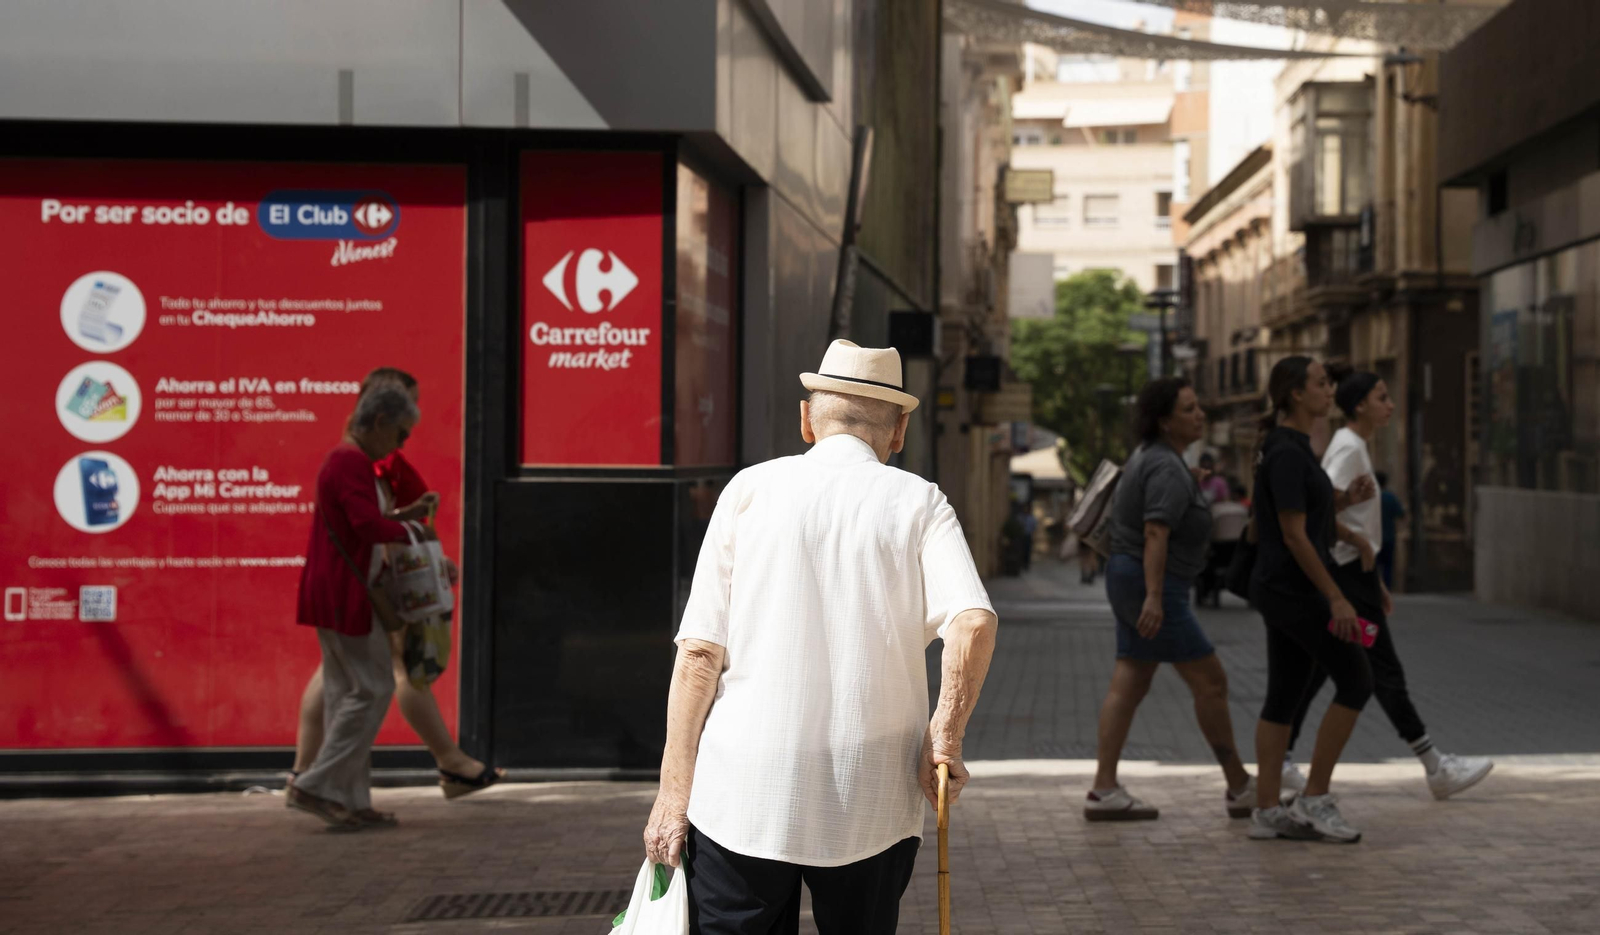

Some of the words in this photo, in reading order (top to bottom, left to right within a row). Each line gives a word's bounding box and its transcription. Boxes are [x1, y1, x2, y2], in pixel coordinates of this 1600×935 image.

[41, 199, 90, 223] Por
[94, 205, 137, 223] ser
[141, 200, 209, 224] socio
[215, 201, 250, 225] de
[269, 204, 290, 224] El
[297, 204, 347, 225] Club
[330, 237, 397, 266] ¿Vienes?
[159, 296, 190, 309] Todo
[192, 297, 206, 309] tu
[207, 297, 246, 309] ahorro
[247, 300, 255, 311] y
[258, 298, 276, 309] tus
[279, 298, 343, 310] descuentos
[345, 298, 382, 312] juntos
[159, 315, 176, 325] en
[177, 313, 191, 325] tu
[192, 310, 315, 328] ChequeAhorro
[529, 321, 649, 345] Carrefour
[548, 347, 632, 370] market
[155, 377, 215, 393] Ahorra
[219, 377, 235, 393] el
[238, 377, 271, 393] IVA
[274, 380, 297, 393] en
[299, 378, 359, 393] frescos
[155, 398, 175, 409] por
[177, 398, 196, 408] ser
[198, 398, 235, 410] mayor
[237, 396, 254, 408] de
[155, 410, 192, 421] menor
[194, 409, 211, 421] de
[212, 409, 230, 421] 30
[231, 411, 240, 421] o
[153, 465, 214, 481] Ahorra
[217, 468, 248, 481] con
[252, 465, 269, 481] la
[152, 482, 191, 499] App
[193, 482, 215, 498] Mi
[218, 482, 301, 498] Carrefour
[152, 501, 205, 514] Cupones
[207, 503, 230, 514] que
[232, 503, 248, 513] se
[248, 501, 295, 514] adaptan
[298, 503, 307, 513] a
